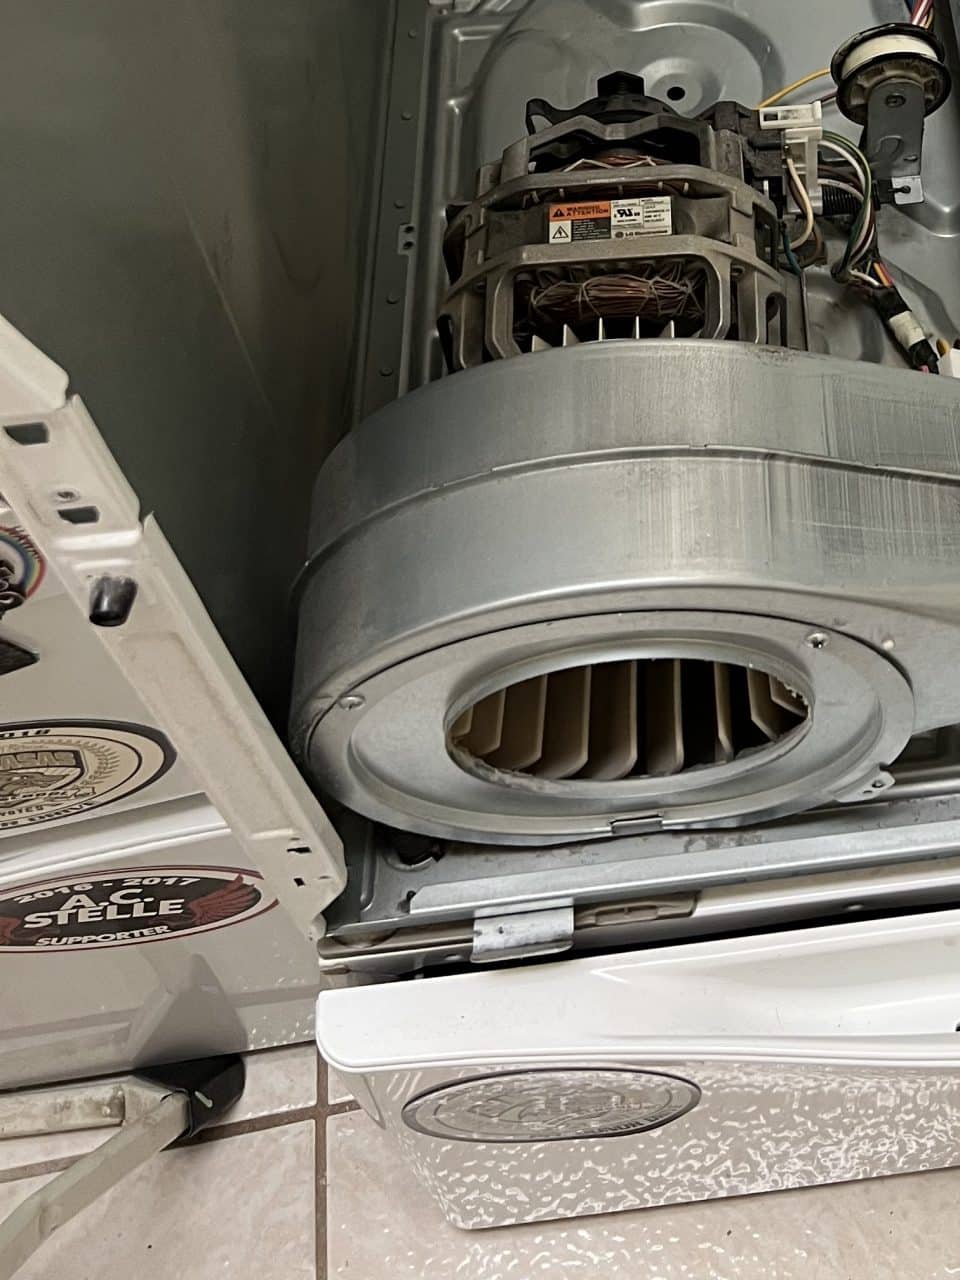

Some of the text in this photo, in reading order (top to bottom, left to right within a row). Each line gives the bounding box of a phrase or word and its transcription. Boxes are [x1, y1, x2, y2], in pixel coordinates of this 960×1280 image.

[13, 883, 93, 904] 2016
[122, 877, 201, 887] 2017
[59, 888, 155, 911] A.C.
[23, 898, 185, 929] STELLE
[34, 925, 172, 947] SUPPORTER
